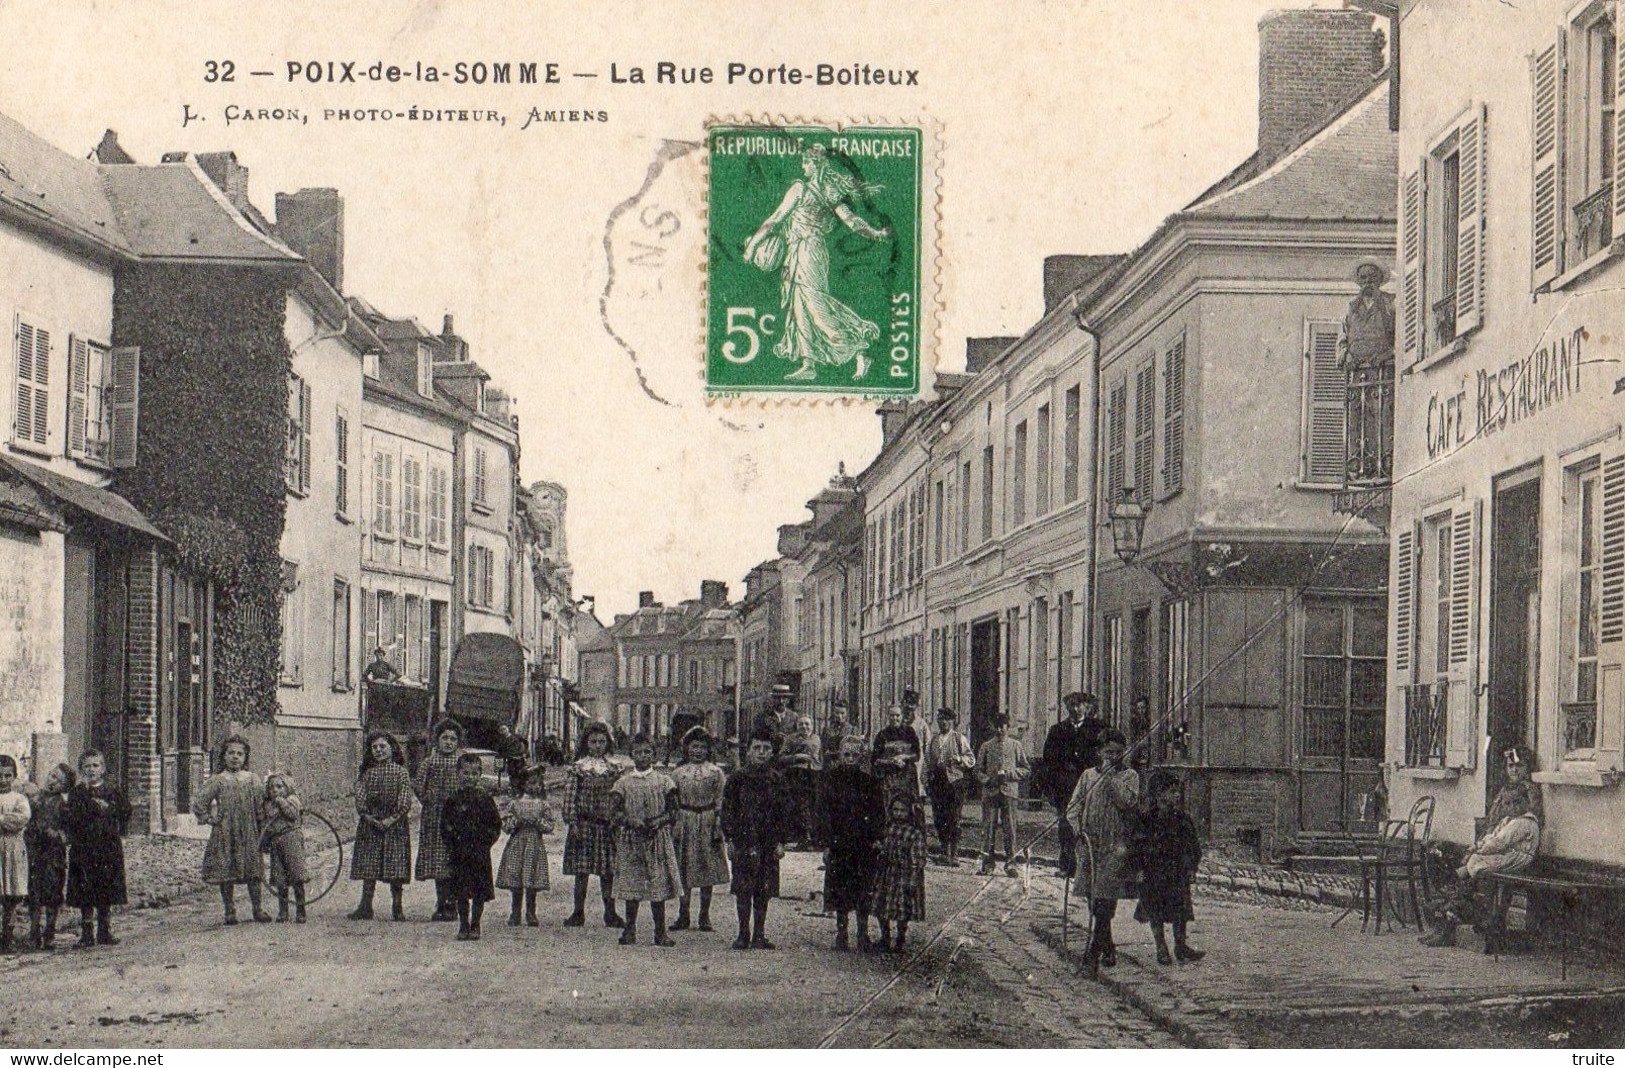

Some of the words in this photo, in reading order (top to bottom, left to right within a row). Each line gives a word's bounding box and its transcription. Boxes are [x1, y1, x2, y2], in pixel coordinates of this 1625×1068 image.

[831, 138, 912, 159] FRANÇAISE
[890, 292, 911, 378] POSTES
[1426, 380, 1466, 461] CAFÉ
[1475, 325, 1584, 438] RESTAURANT
